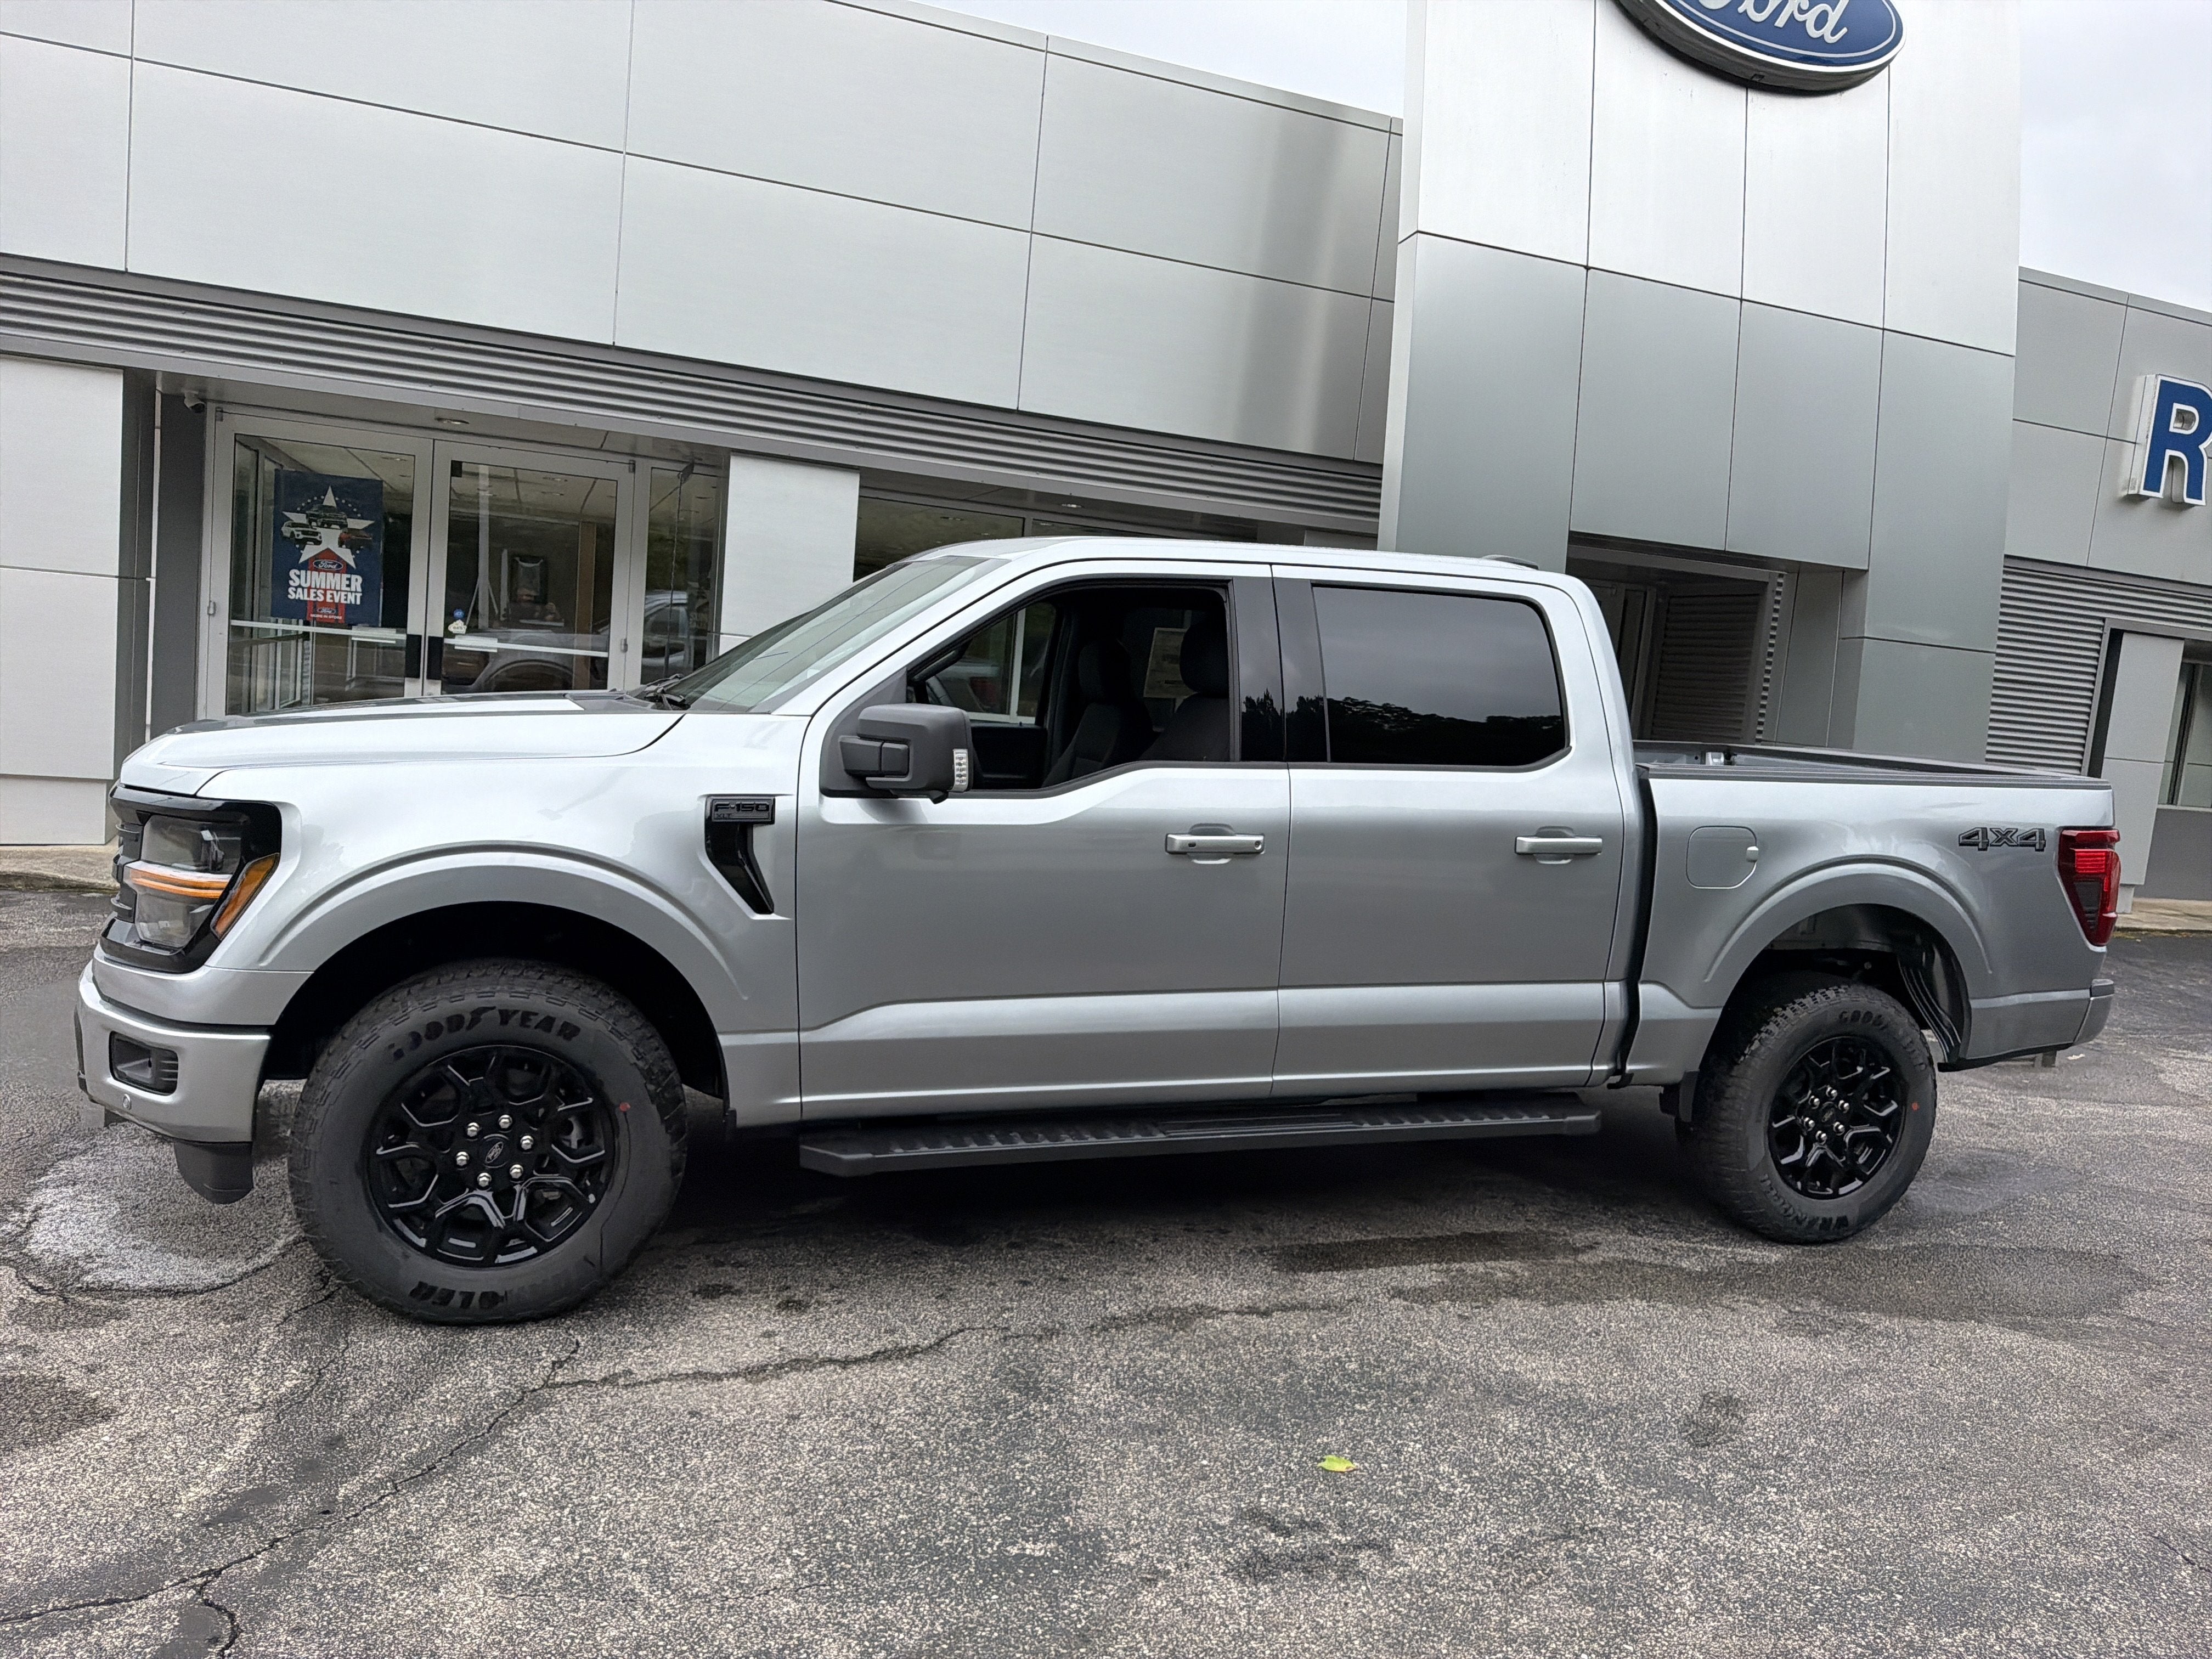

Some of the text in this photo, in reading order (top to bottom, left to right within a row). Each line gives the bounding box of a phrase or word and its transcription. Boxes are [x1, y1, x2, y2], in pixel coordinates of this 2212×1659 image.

[1700, 0, 1848, 43] ord
[289, 569, 363, 592] SUMMER
[287, 587, 363, 605] SALES EVENT
[715, 801, 769, 812] F-150
